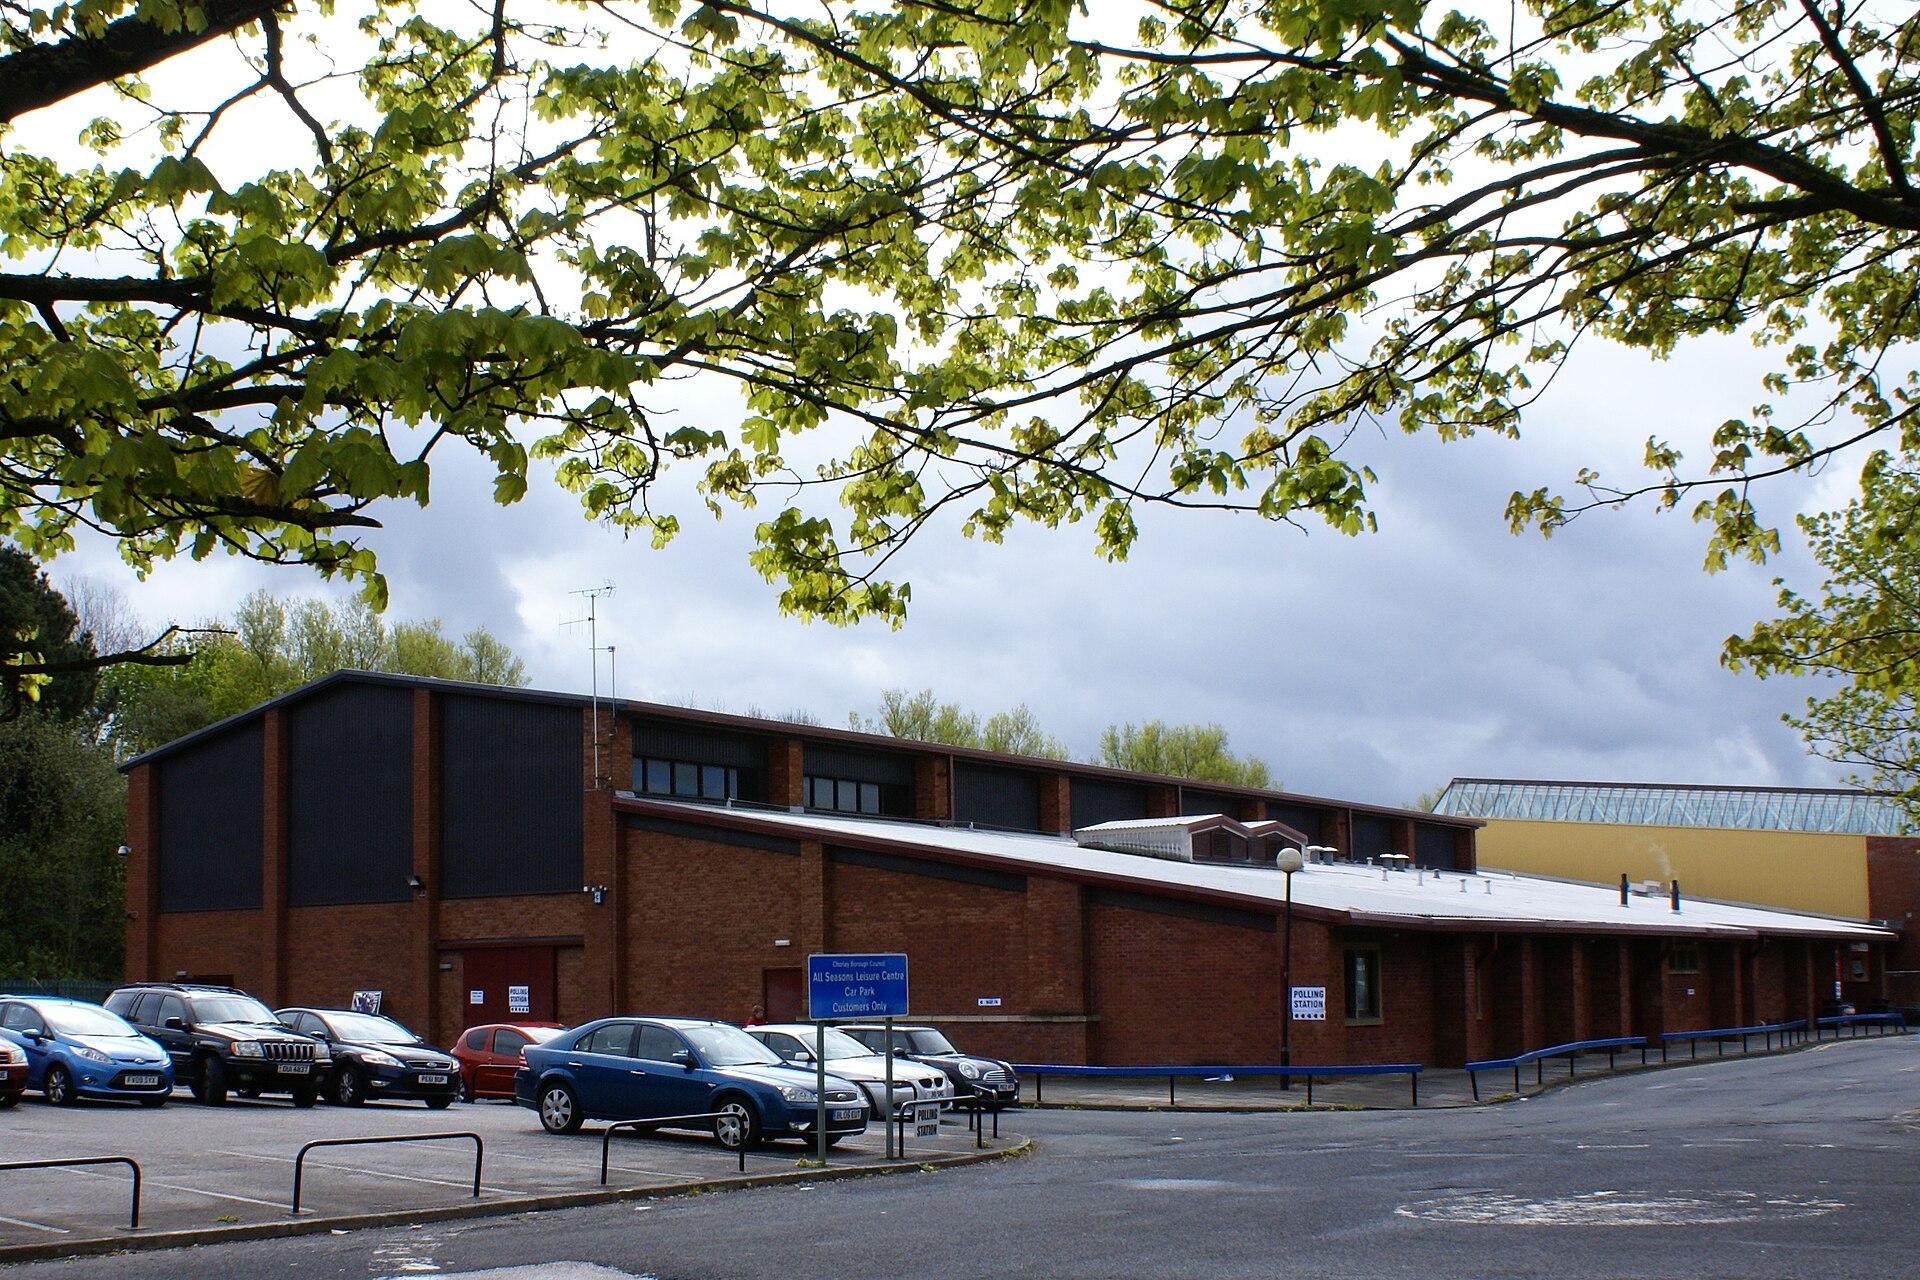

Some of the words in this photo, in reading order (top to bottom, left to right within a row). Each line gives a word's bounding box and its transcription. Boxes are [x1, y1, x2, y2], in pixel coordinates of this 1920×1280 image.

[813, 972, 823, 982] All
[825, 971, 853, 982] Seasons
[856, 971, 880, 981] Leisure
[881, 970, 905, 980] Centre
[844, 986, 857, 997] Car
[860, 986, 875, 996] Park
[1293, 990, 1324, 998] POLLING
[832, 1002, 869, 1012] Customers
[871, 1000, 887, 1011] Only
[1293, 1000, 1324, 1008] STATION
[917, 1109, 938, 1121] POLLING
[917, 1124, 938, 1137] STATION
